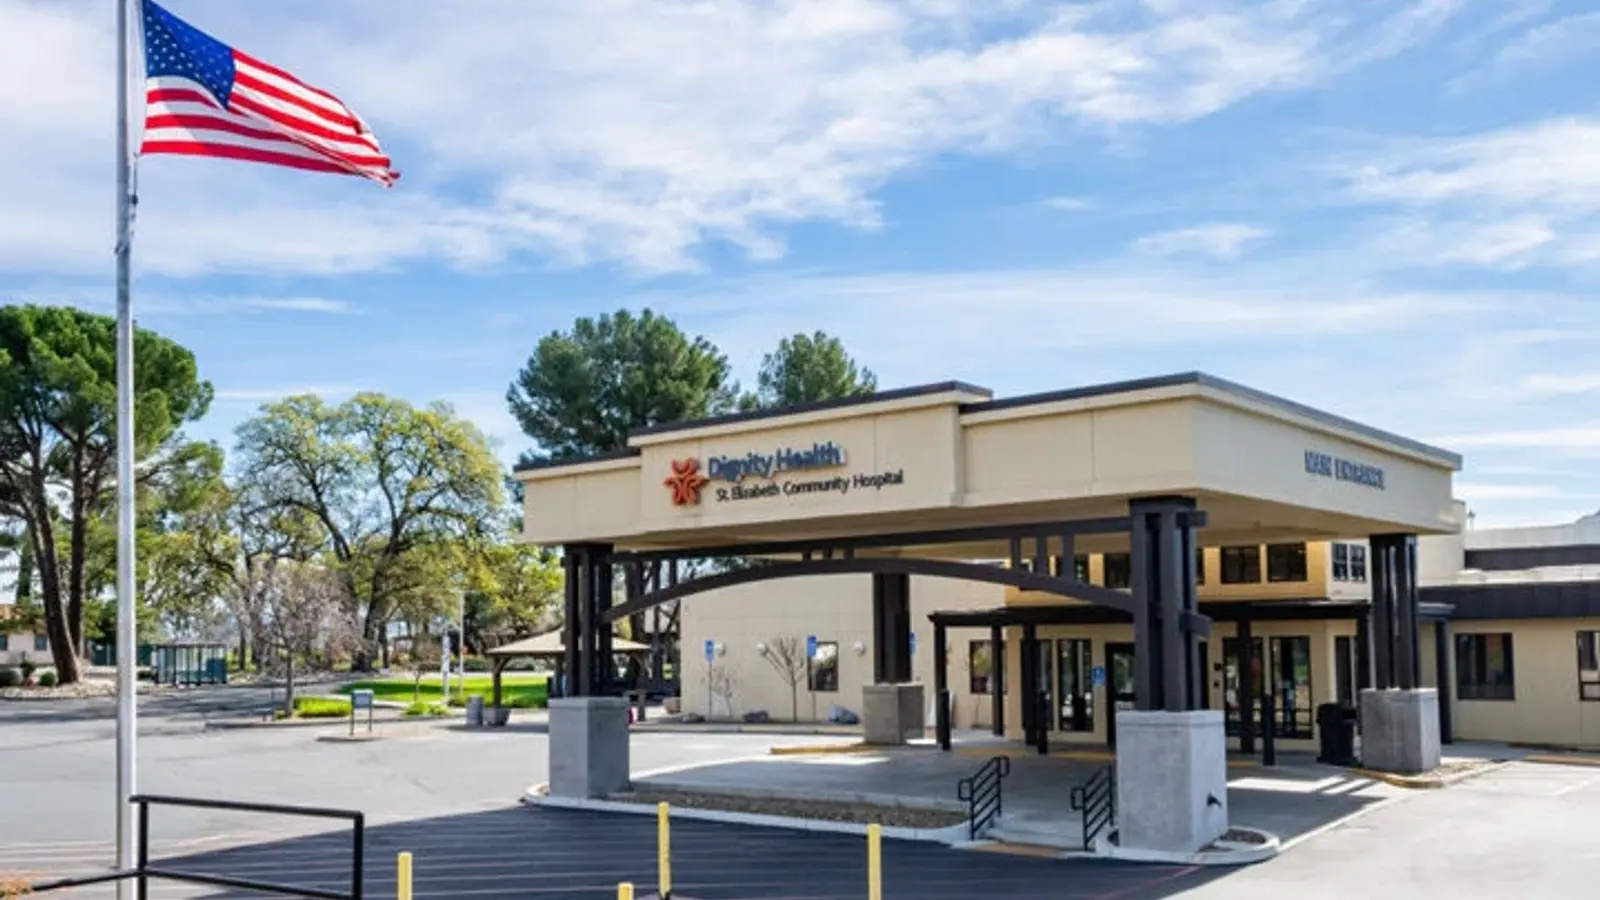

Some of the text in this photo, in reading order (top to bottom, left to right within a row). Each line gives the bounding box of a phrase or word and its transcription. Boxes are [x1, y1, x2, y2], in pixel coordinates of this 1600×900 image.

[709, 441, 844, 482] Dignity Health
[732, 482, 781, 500] Elizabeth
[783, 475, 850, 496] Community
[853, 469, 904, 491] Hospital
